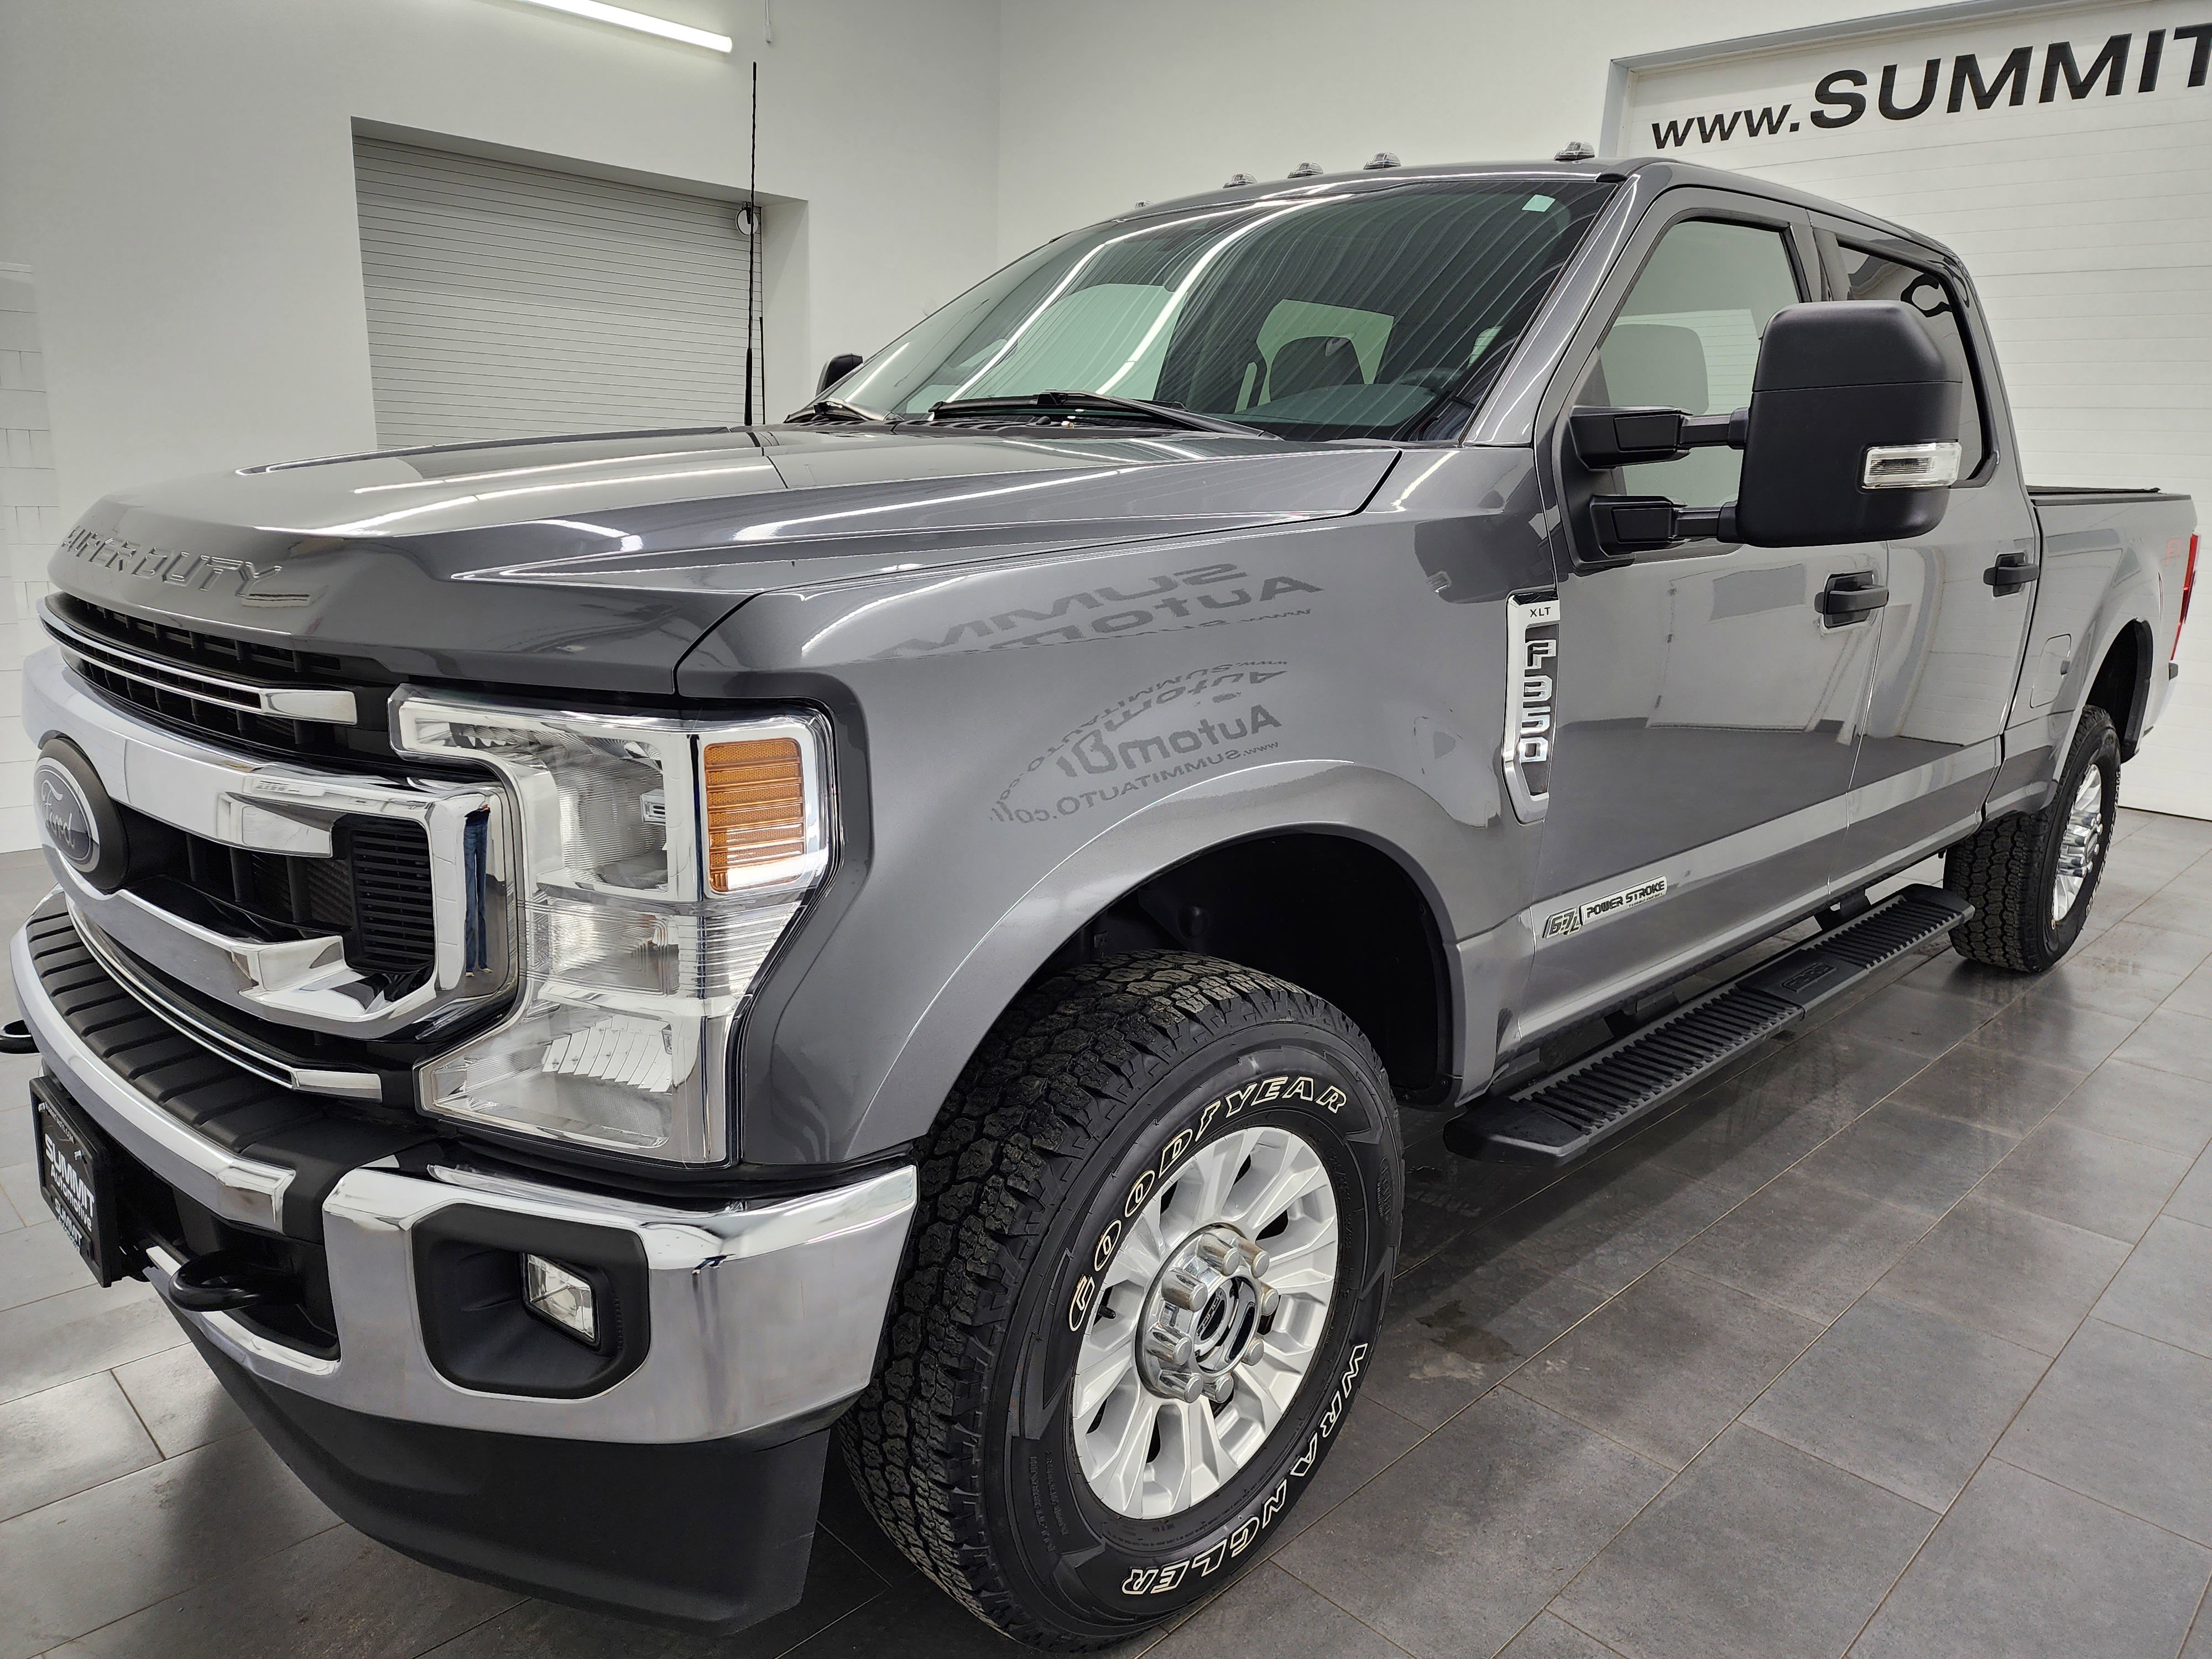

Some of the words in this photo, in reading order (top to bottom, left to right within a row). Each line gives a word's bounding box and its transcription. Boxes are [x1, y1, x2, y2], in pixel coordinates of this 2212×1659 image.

[132, 546, 283, 597] DUTY
[1530, 607, 1551, 617] XLT
[41, 779, 76, 850] Ford
[1586, 896, 1624, 919] POWER
[1625, 880, 1665, 904] STROKE
[45, 1133, 95, 1218] SUMMIT
[50, 1164, 92, 1233] Automotive
[1068, 1076, 1346, 1332] GOODYEAR
[1121, 1342, 1368, 1595] WRANGLER
